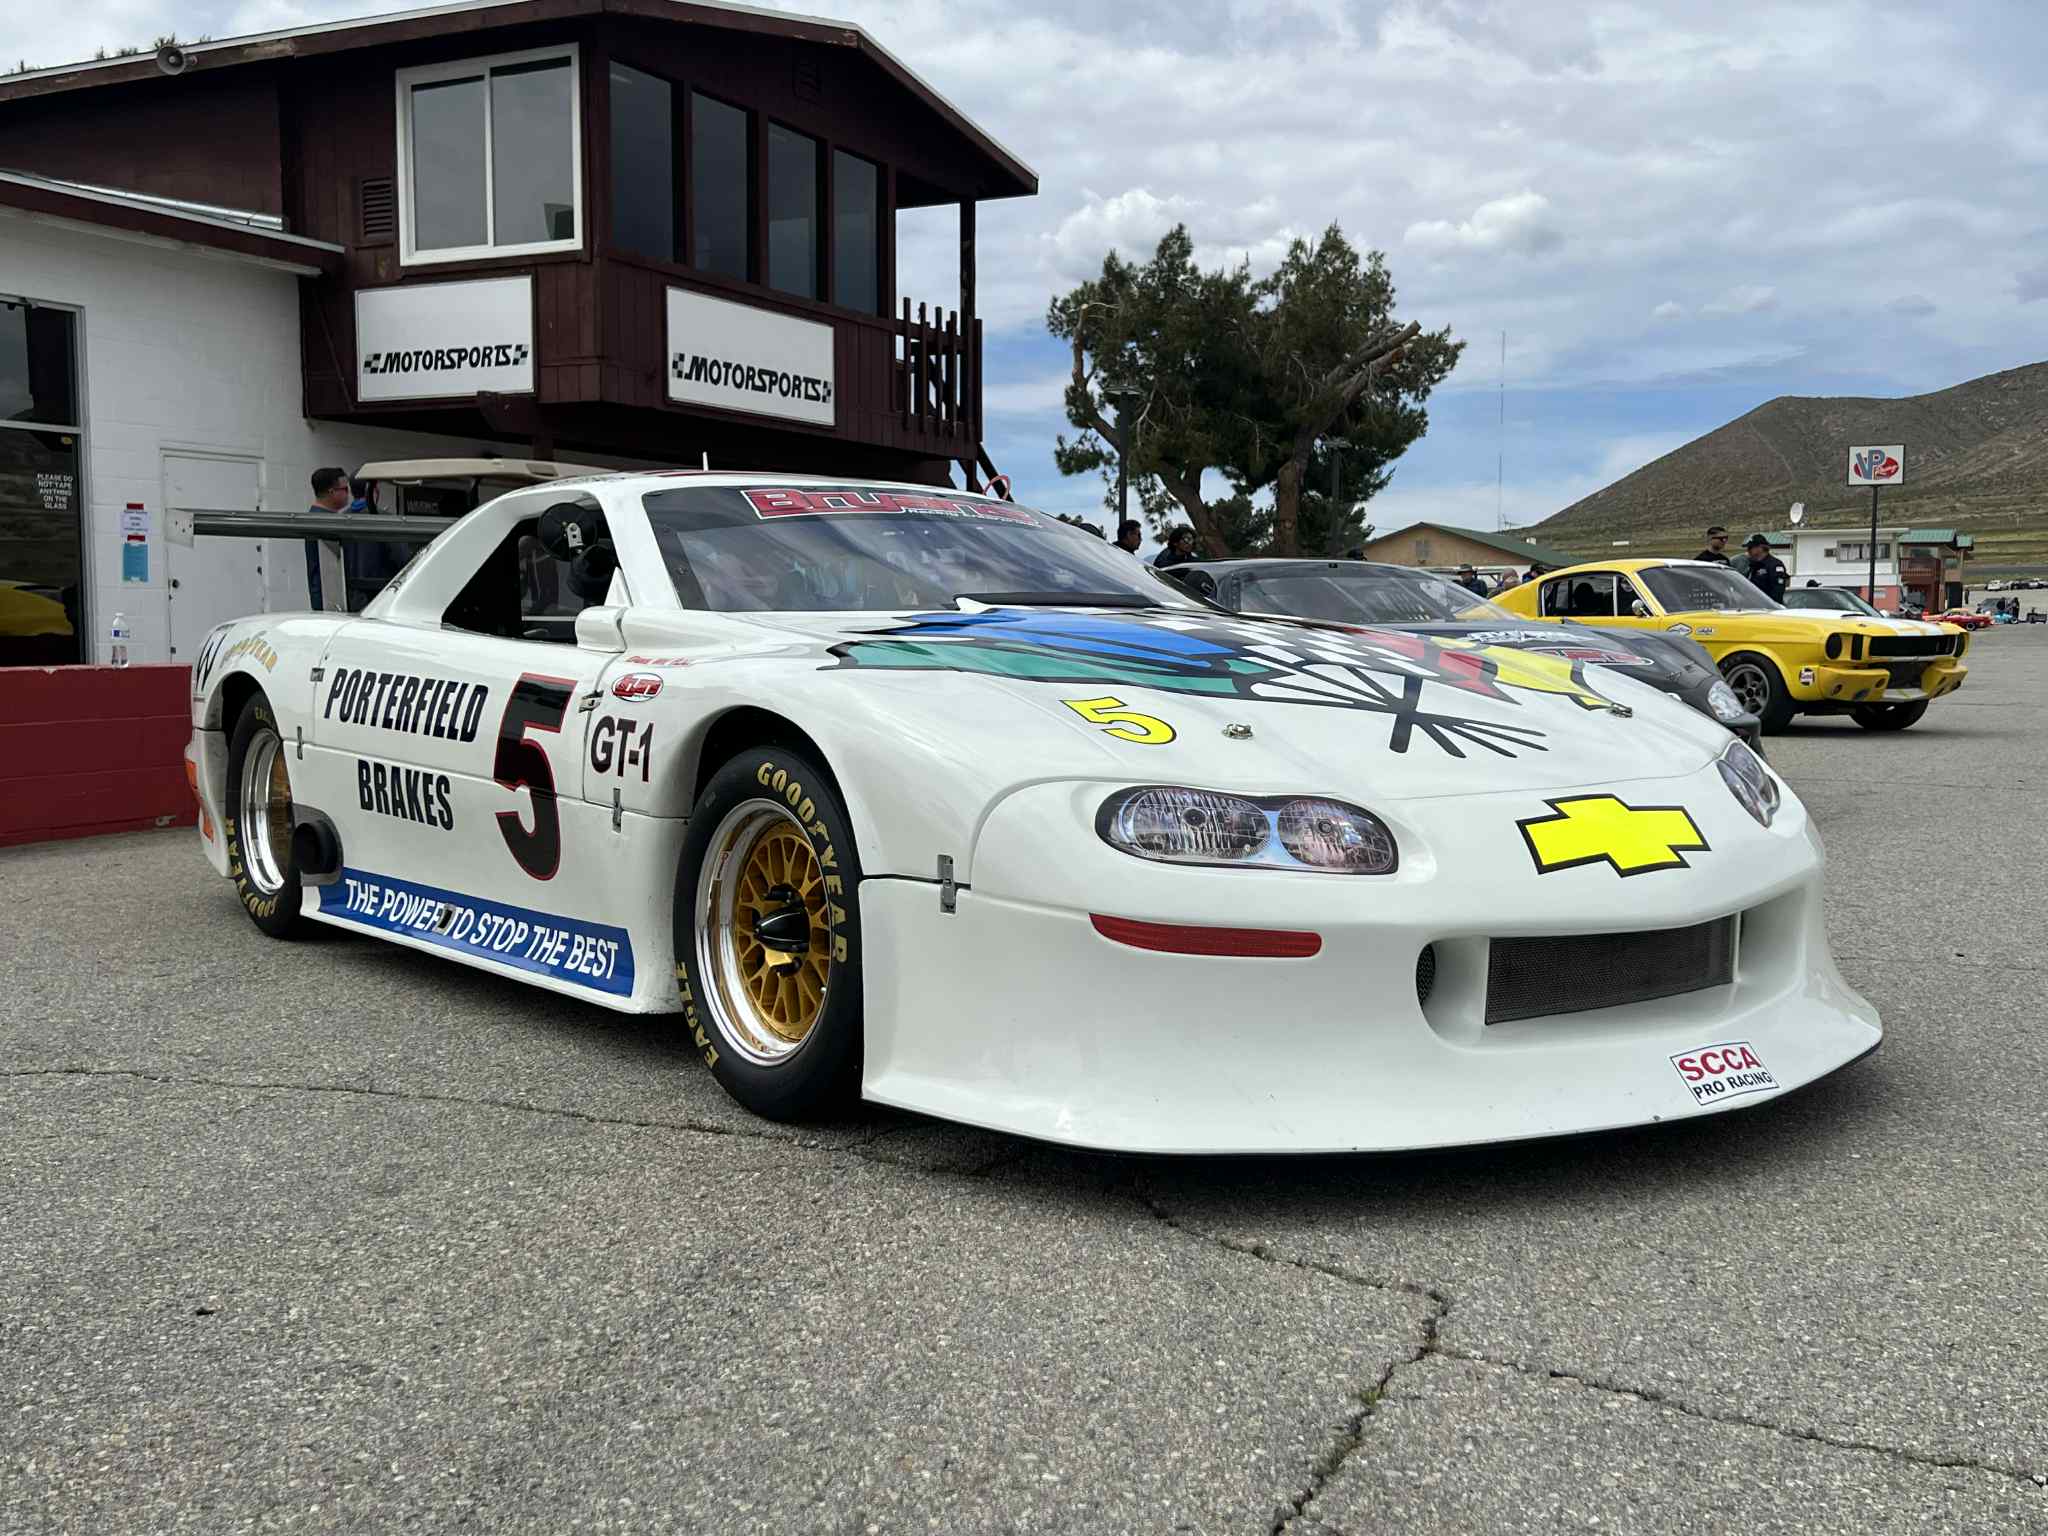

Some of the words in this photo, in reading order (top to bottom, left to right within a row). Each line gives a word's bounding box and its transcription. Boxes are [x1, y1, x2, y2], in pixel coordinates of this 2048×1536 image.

[379, 344, 512, 374] MOTORSPORTS
[684, 355, 821, 402] MOTORSPORTS
[37, 473, 61, 481] PLEASE
[38, 480, 53, 488] NOT
[1856, 449, 1885, 480] VP
[40, 488, 72, 497] ANYTHING
[43, 495, 53, 503] ON
[44, 502, 67, 510] GLASS
[324, 668, 488, 742] PORTERFIELD
[1059, 696, 1177, 745] 5
[590, 715, 654, 782] GT-1
[358, 759, 454, 831] BRAKES
[493, 672, 578, 881] 5
[757, 762, 848, 963] GOODYEAR
[345, 878, 380, 915] THE
[443, 906, 475, 940] TO
[469, 912, 529, 953] STOP
[524, 925, 569, 966] THE
[564, 934, 619, 979] BEST
[674, 961, 720, 1069] EAGLE
[1678, 1046, 1762, 1081] SCCA
[1692, 1080, 1726, 1099] PRO
[1726, 1071, 1773, 1089] RACING
